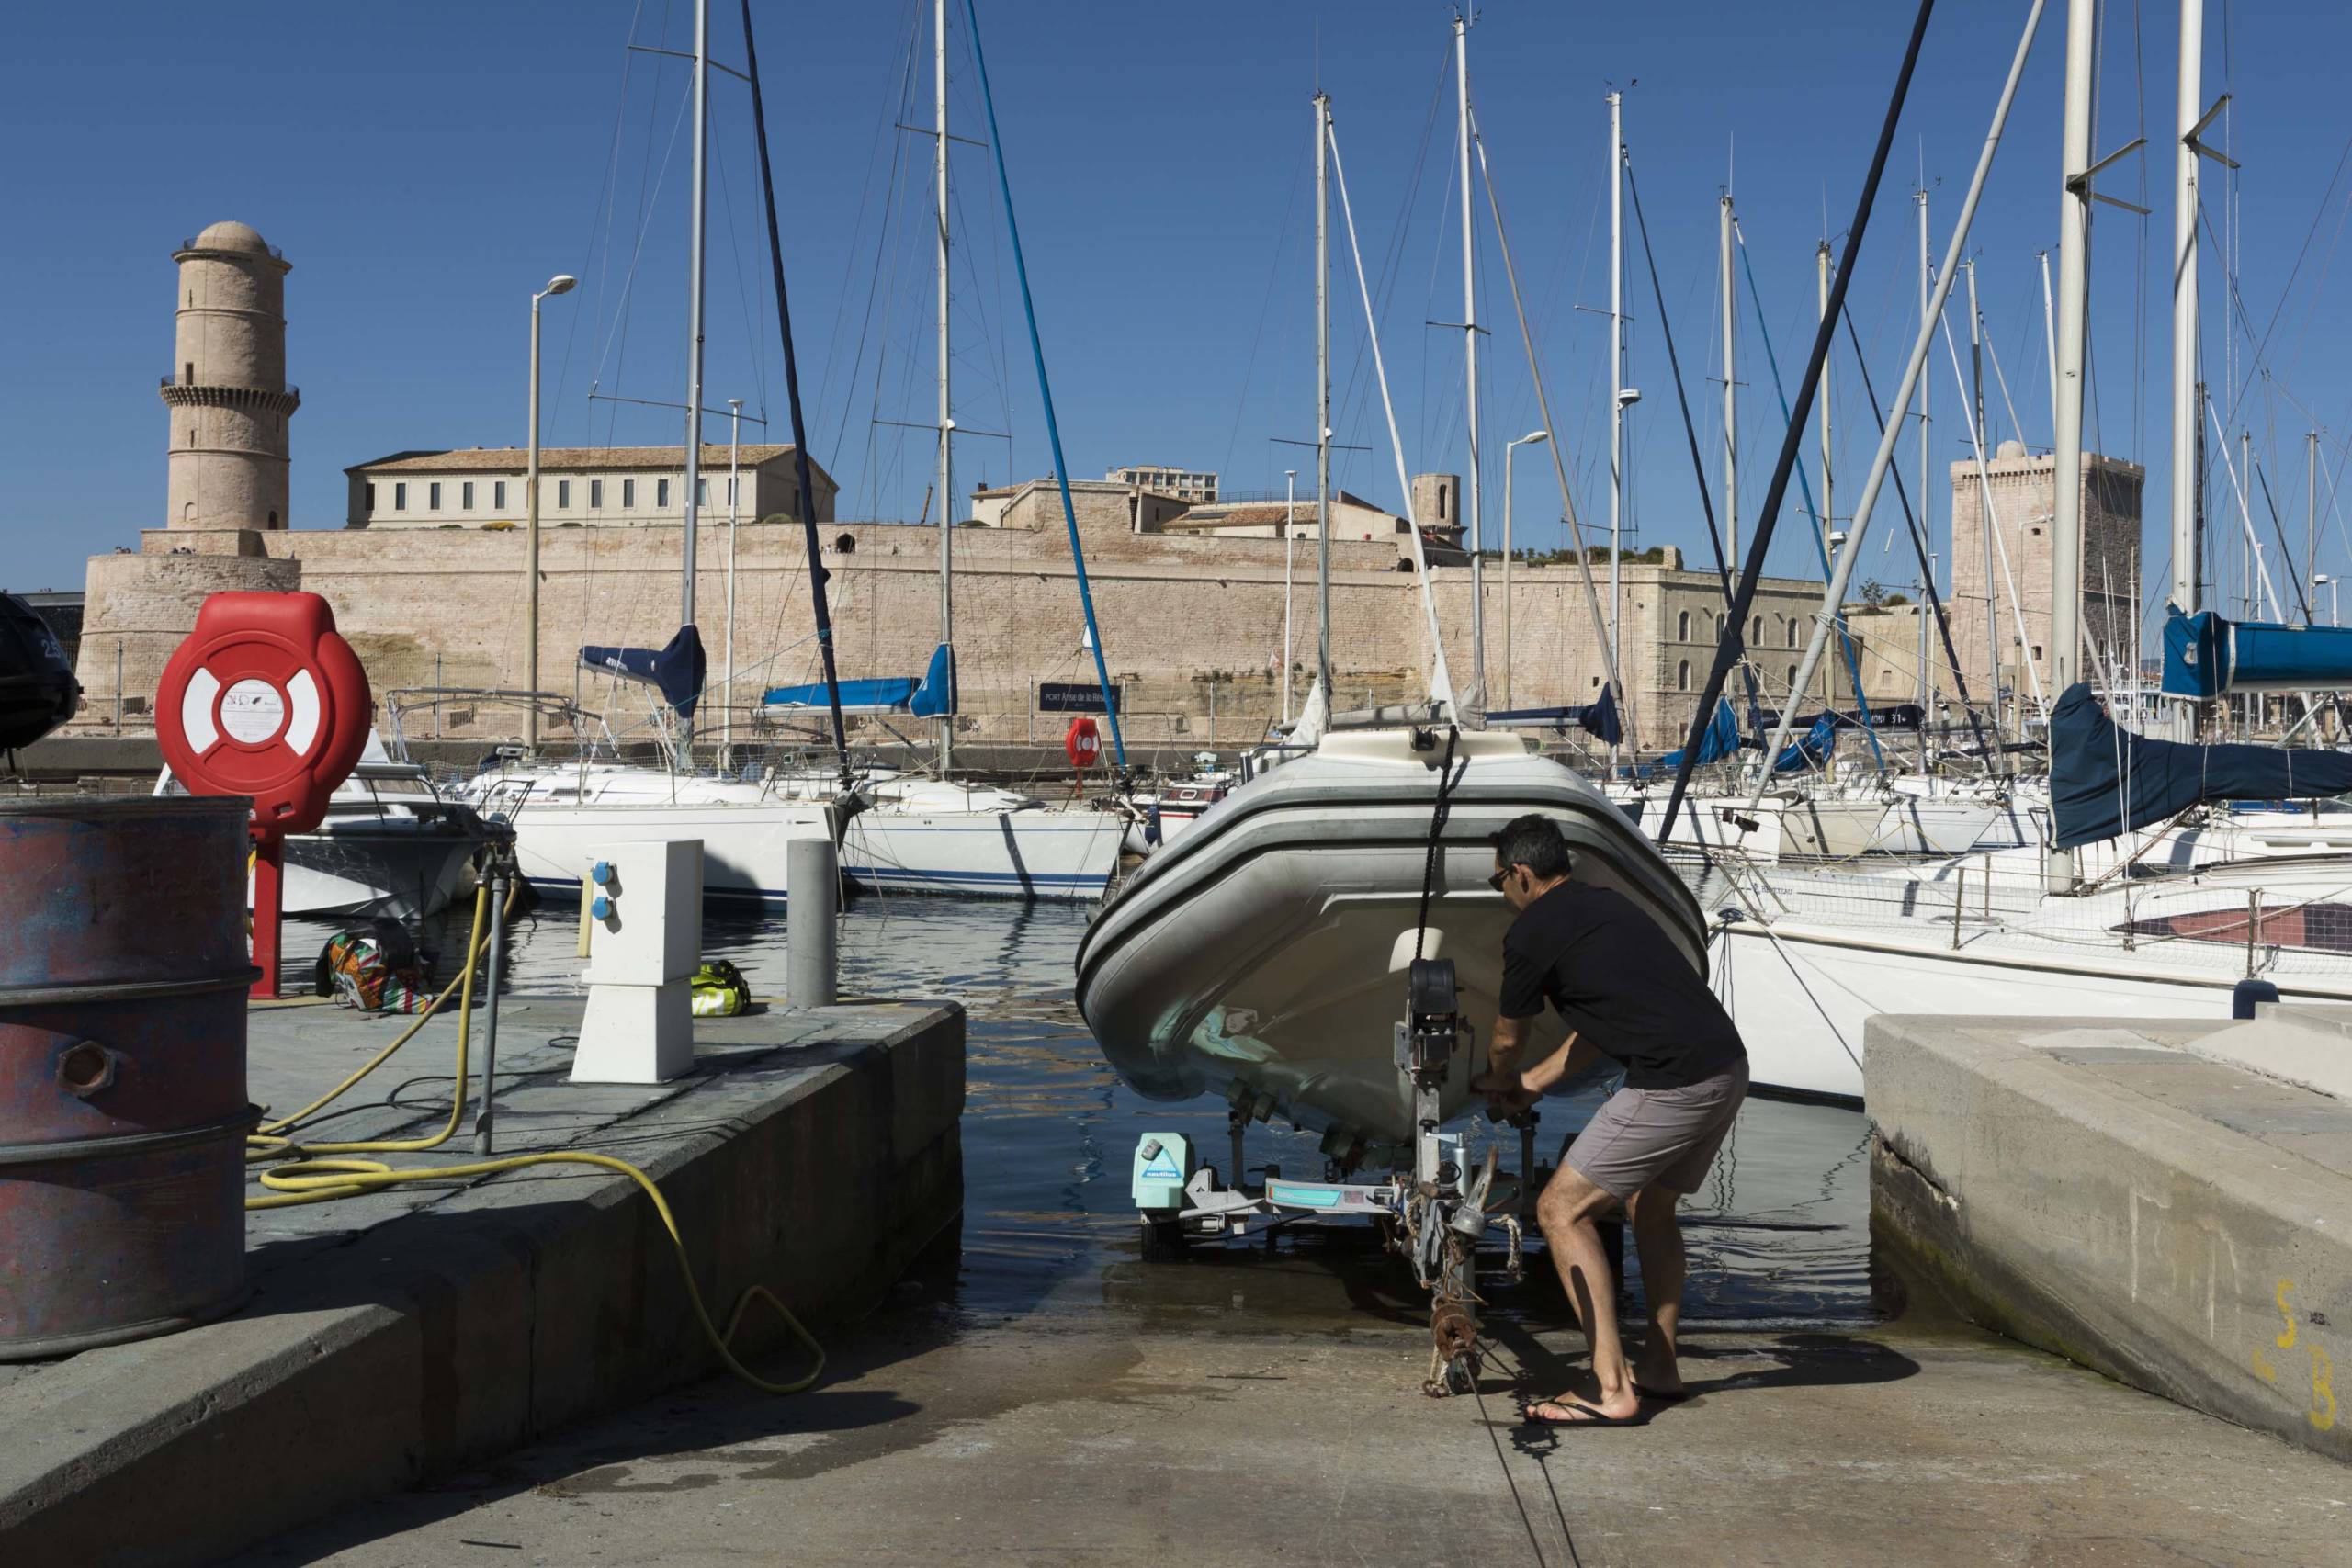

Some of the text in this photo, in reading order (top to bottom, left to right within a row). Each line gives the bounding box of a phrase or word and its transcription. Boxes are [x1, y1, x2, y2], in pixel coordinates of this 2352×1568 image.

[1046, 693, 1061, 701] PORT
[1078, 693, 1085, 702] de
[1086, 693, 1092, 703] la
[1092, 693, 1116, 703] Rése
